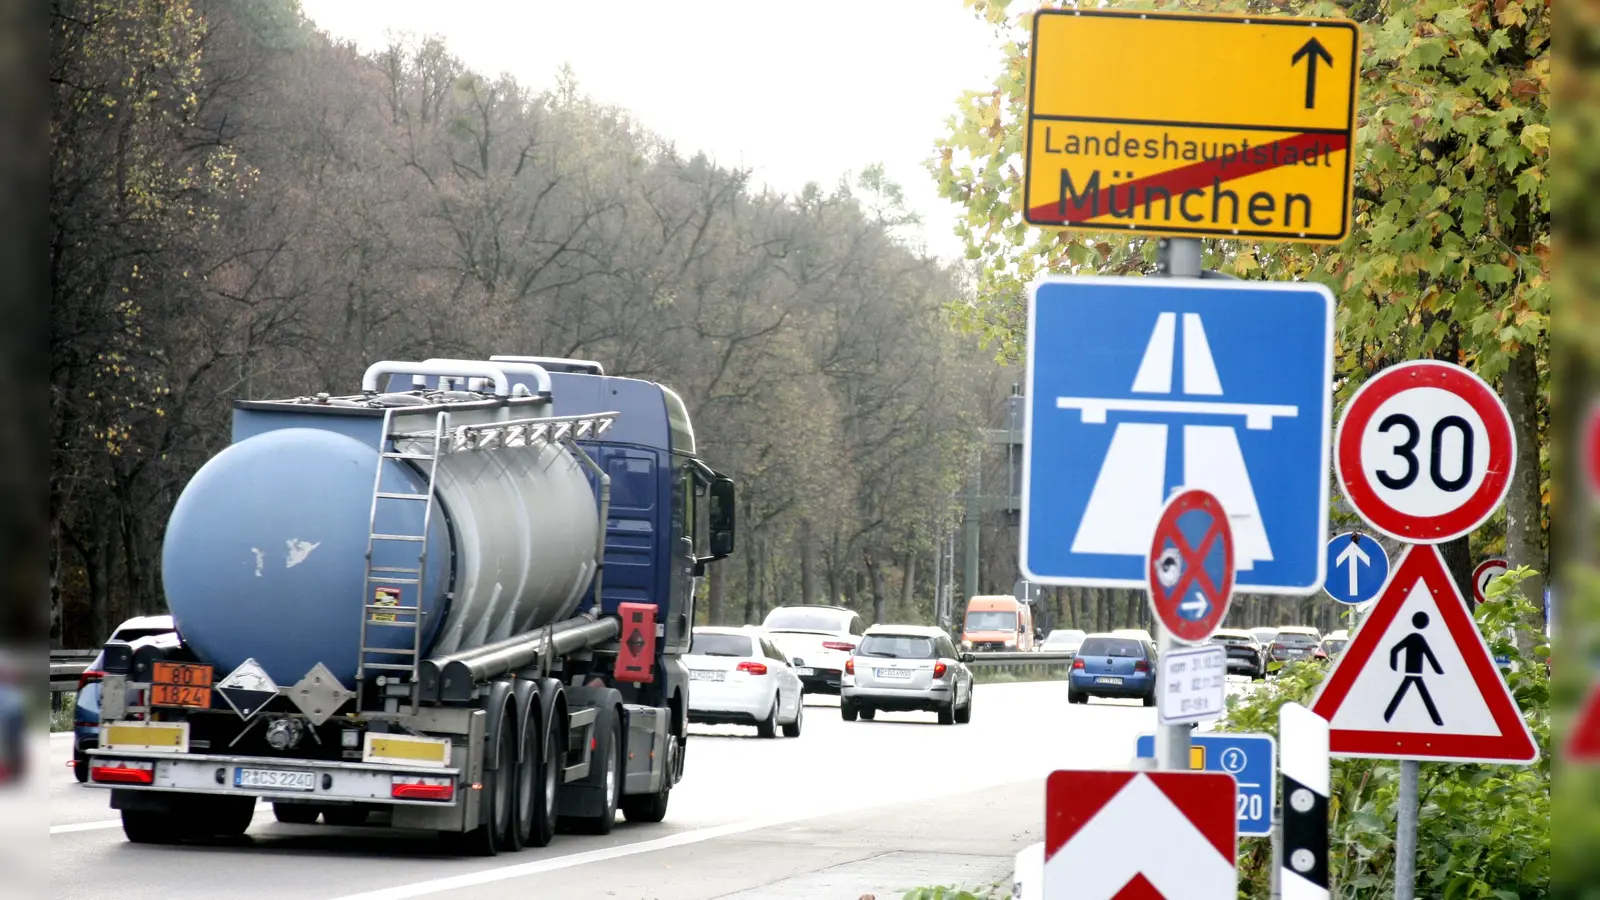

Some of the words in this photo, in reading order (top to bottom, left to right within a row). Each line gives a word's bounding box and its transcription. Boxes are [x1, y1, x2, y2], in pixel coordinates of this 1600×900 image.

[1045, 126, 1332, 170] Landeshauptstadt
[1058, 167, 1312, 228] München
[1375, 413, 1474, 492] 30
[172, 667, 193, 685] 80
[161, 685, 202, 704] 1824
[1229, 752, 1238, 768] 2
[260, 771, 277, 785] CS
[280, 772, 313, 787] 2240
